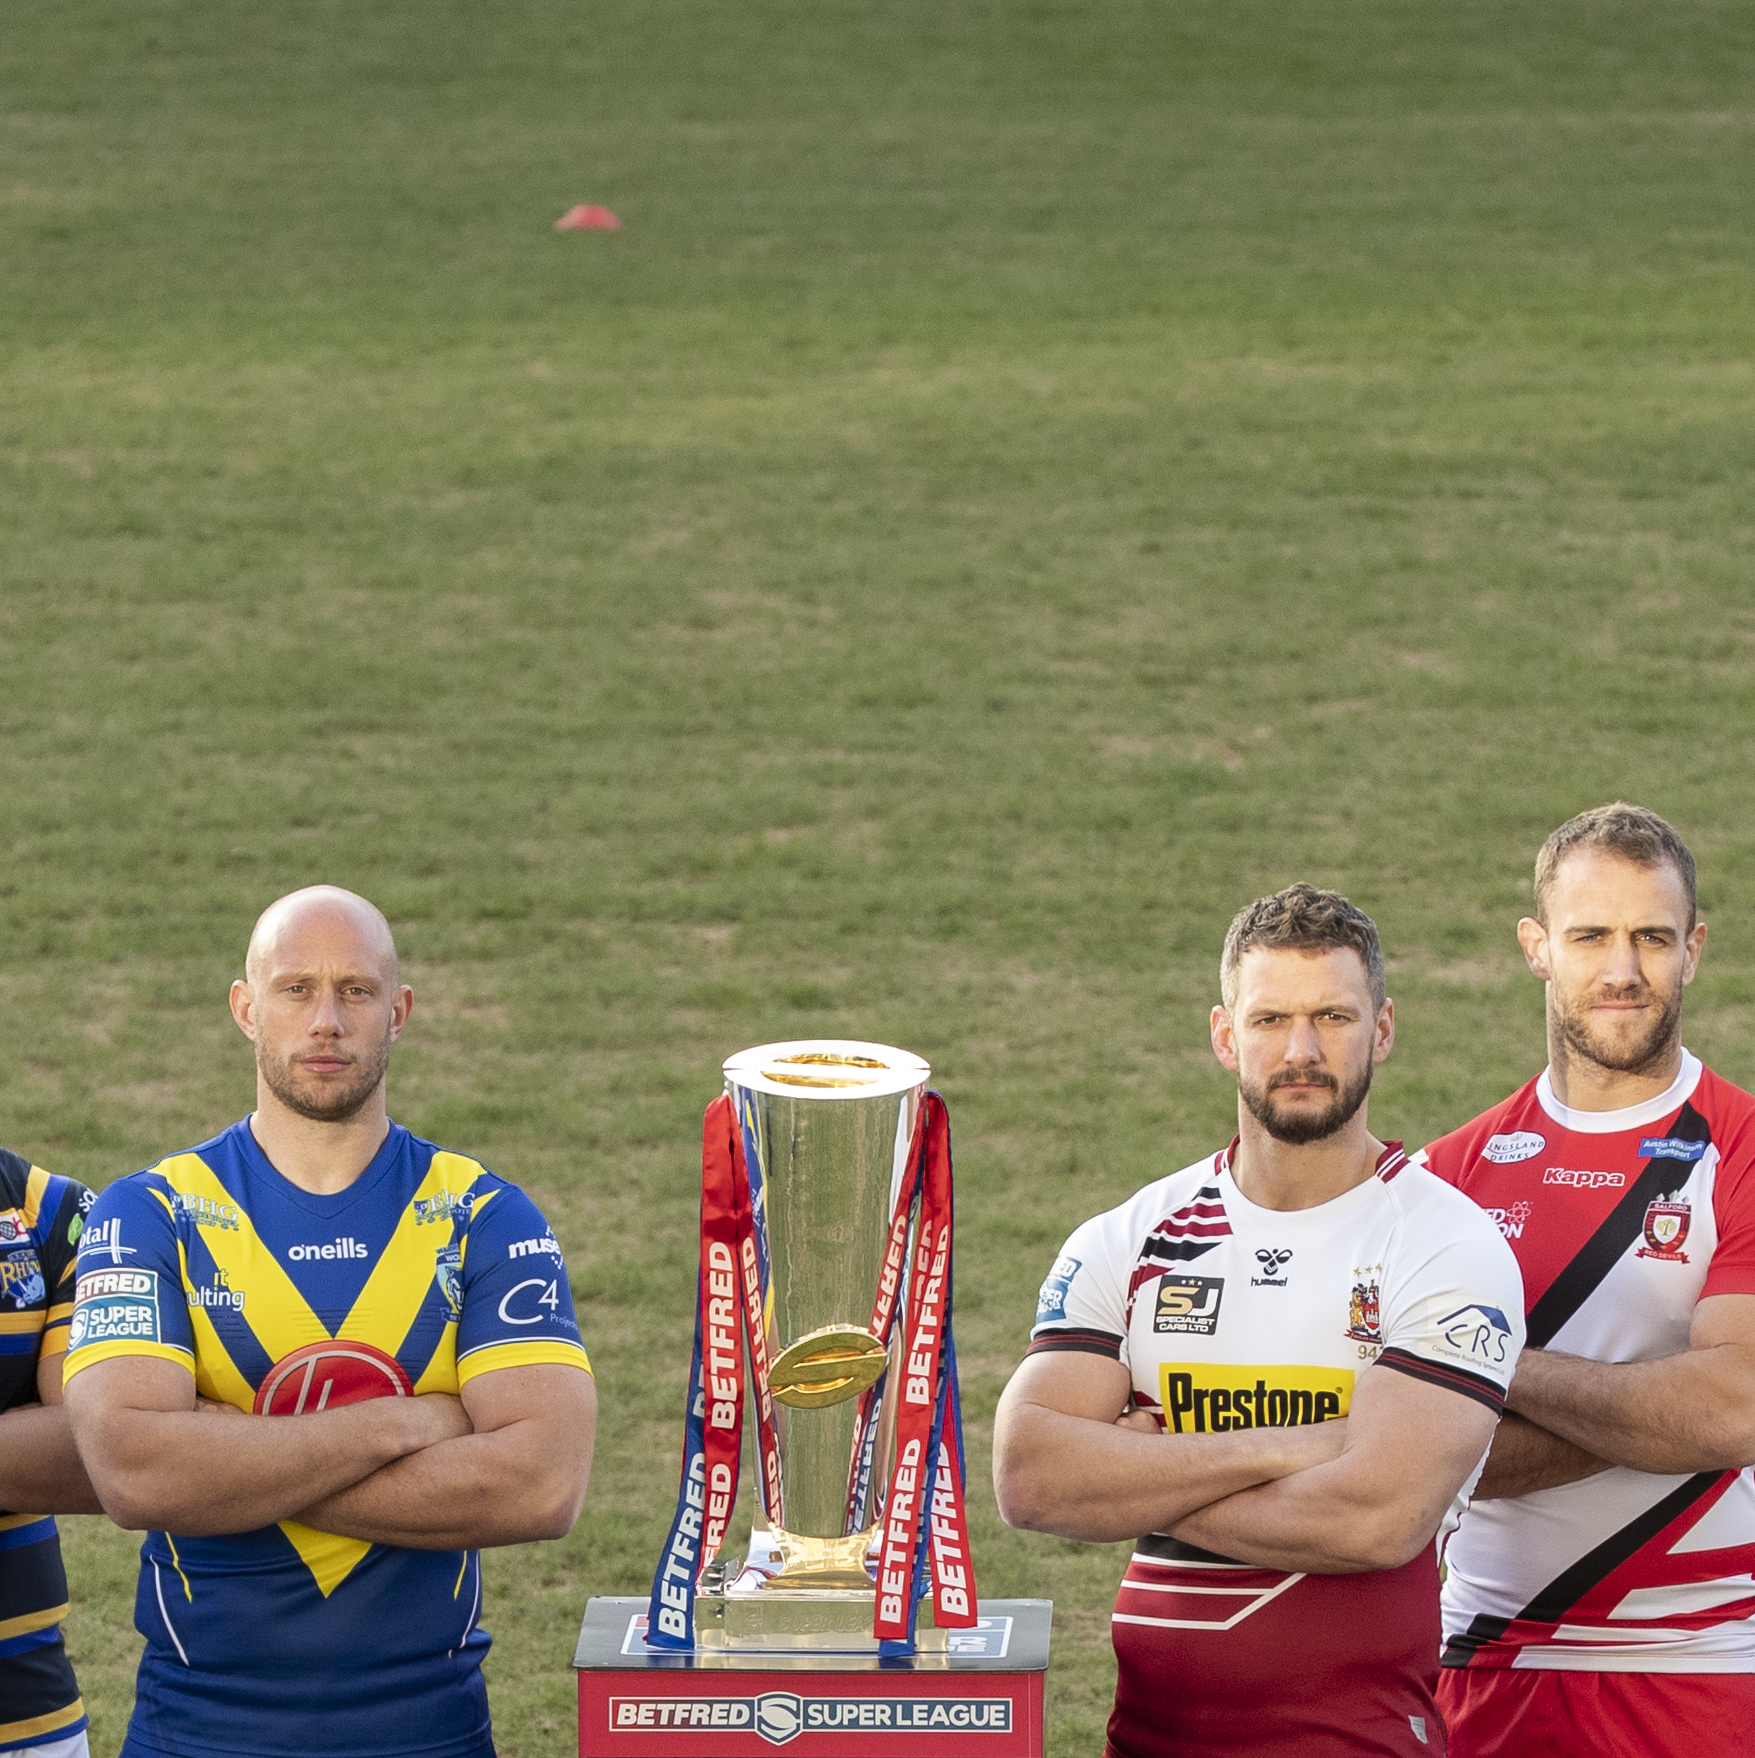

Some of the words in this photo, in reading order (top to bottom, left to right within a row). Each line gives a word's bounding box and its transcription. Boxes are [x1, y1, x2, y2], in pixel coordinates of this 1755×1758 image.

[1487, 1139, 1546, 1152] INGSLAND
[1643, 1140, 1668, 1149] Austin
[1655, 1147, 1691, 1159] Transport
[1489, 1152, 1529, 1162] DRINKS
[1543, 1167, 1626, 1188] Kappa
[76, 1273, 152, 1302] ETFRED
[1250, 1277, 1288, 1287] hummel
[1158, 1285, 1219, 1317] SJ
[90, 1306, 153, 1323] SUPER
[904, 1224, 949, 1406] BETFRED
[1155, 1315, 1216, 1326] SPECIALIST
[87, 1322, 154, 1339] LEAGUE
[708, 1241, 738, 1430] BETFRED
[1158, 1323, 1189, 1332] CARS
[1189, 1324, 1210, 1333] LTD
[1431, 1344, 1461, 1360] Complete
[1445, 1323, 1509, 1363] CRS
[1168, 1372, 1341, 1434] Prestone
[879, 1438, 922, 1624] BETFRED
[929, 1441, 970, 1617] BETFRED
[657, 1452, 705, 1640] BETFRED
[616, 1702, 750, 1727] BETFRED
[807, 1703, 892, 1727] SUPER
[896, 1703, 1006, 1728] LEAGUE
